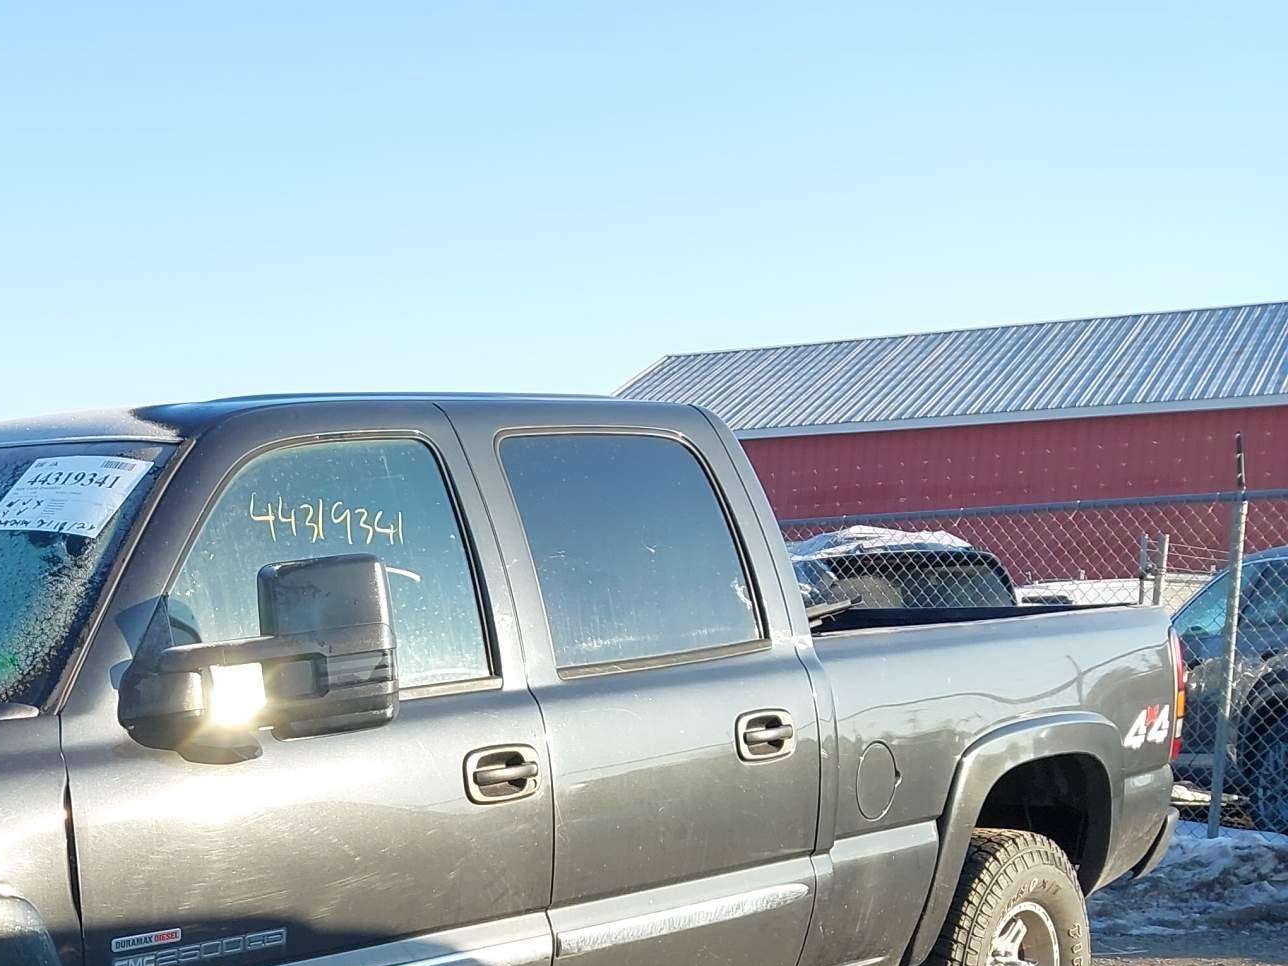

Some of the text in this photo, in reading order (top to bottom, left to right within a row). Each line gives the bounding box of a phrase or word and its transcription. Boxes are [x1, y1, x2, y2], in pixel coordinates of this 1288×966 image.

[27, 471, 120, 490] 44319341
[249, 491, 404, 545] 44319341
[115, 929, 180, 950] DURAMAX DIESEL
